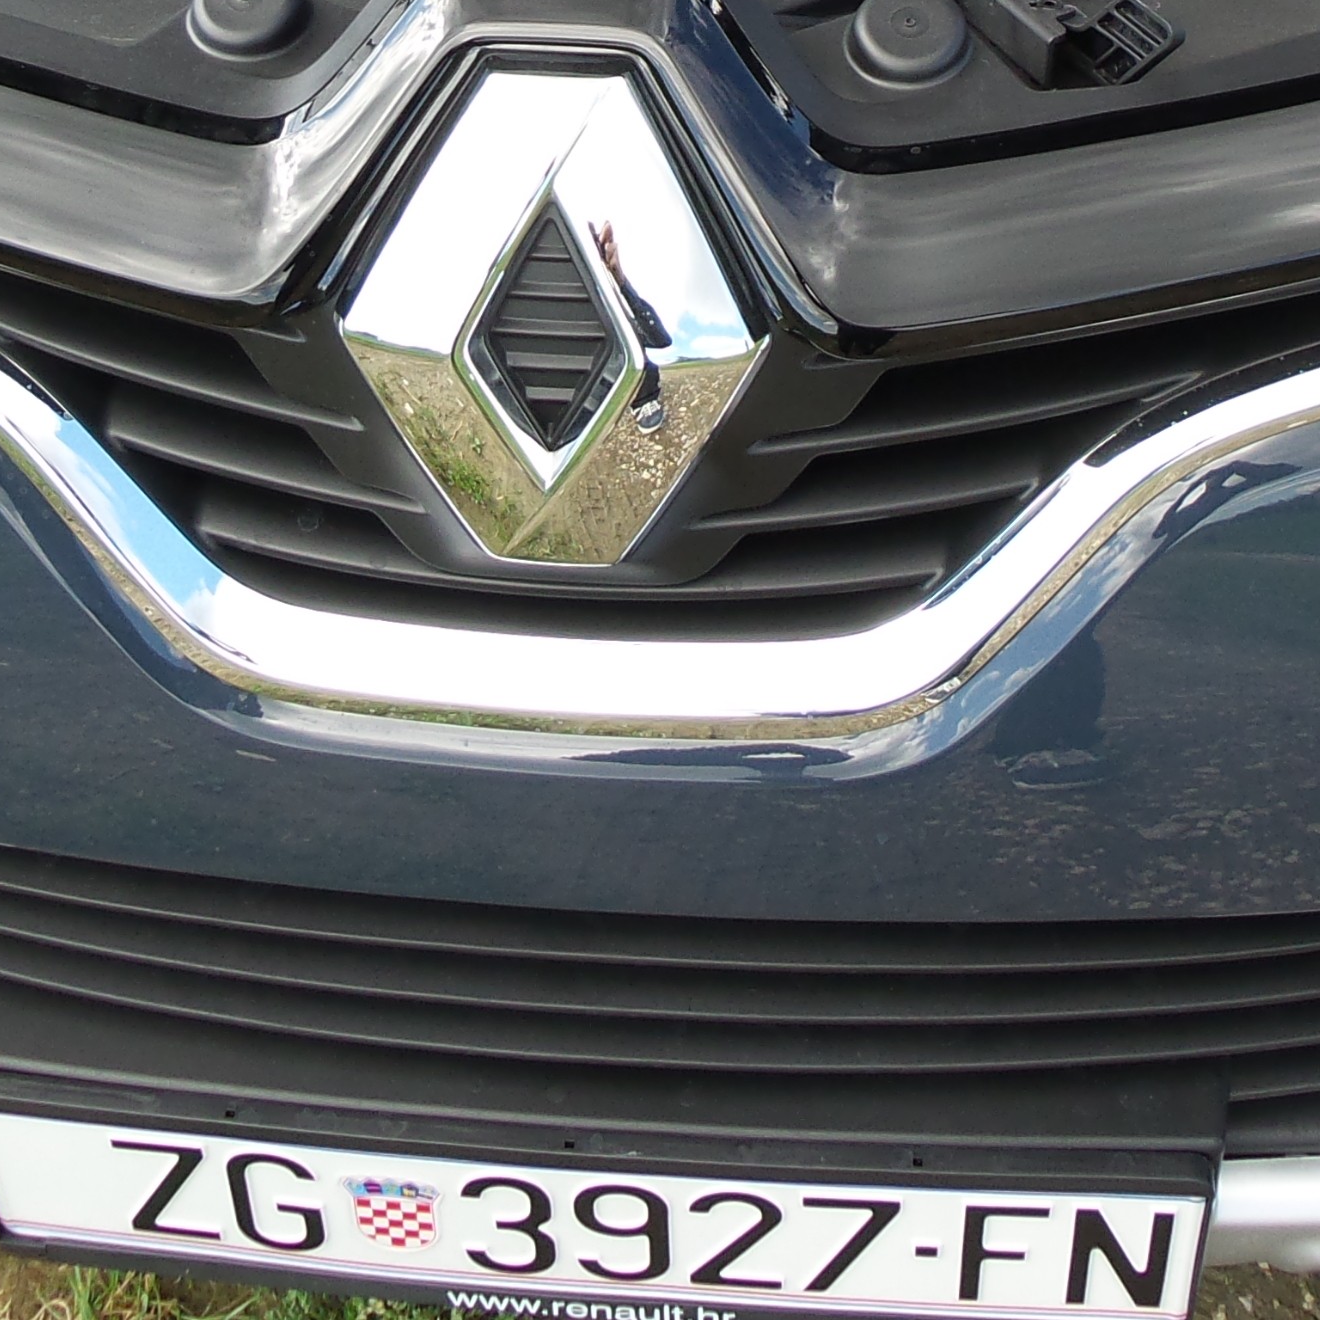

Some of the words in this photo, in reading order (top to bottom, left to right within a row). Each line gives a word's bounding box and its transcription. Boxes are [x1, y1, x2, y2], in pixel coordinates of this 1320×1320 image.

[110, 1140, 326, 1253] ZG
[460, 1174, 1176, 1308] 3927-FN
[447, 1290, 736, 1320] www.renaulthr
